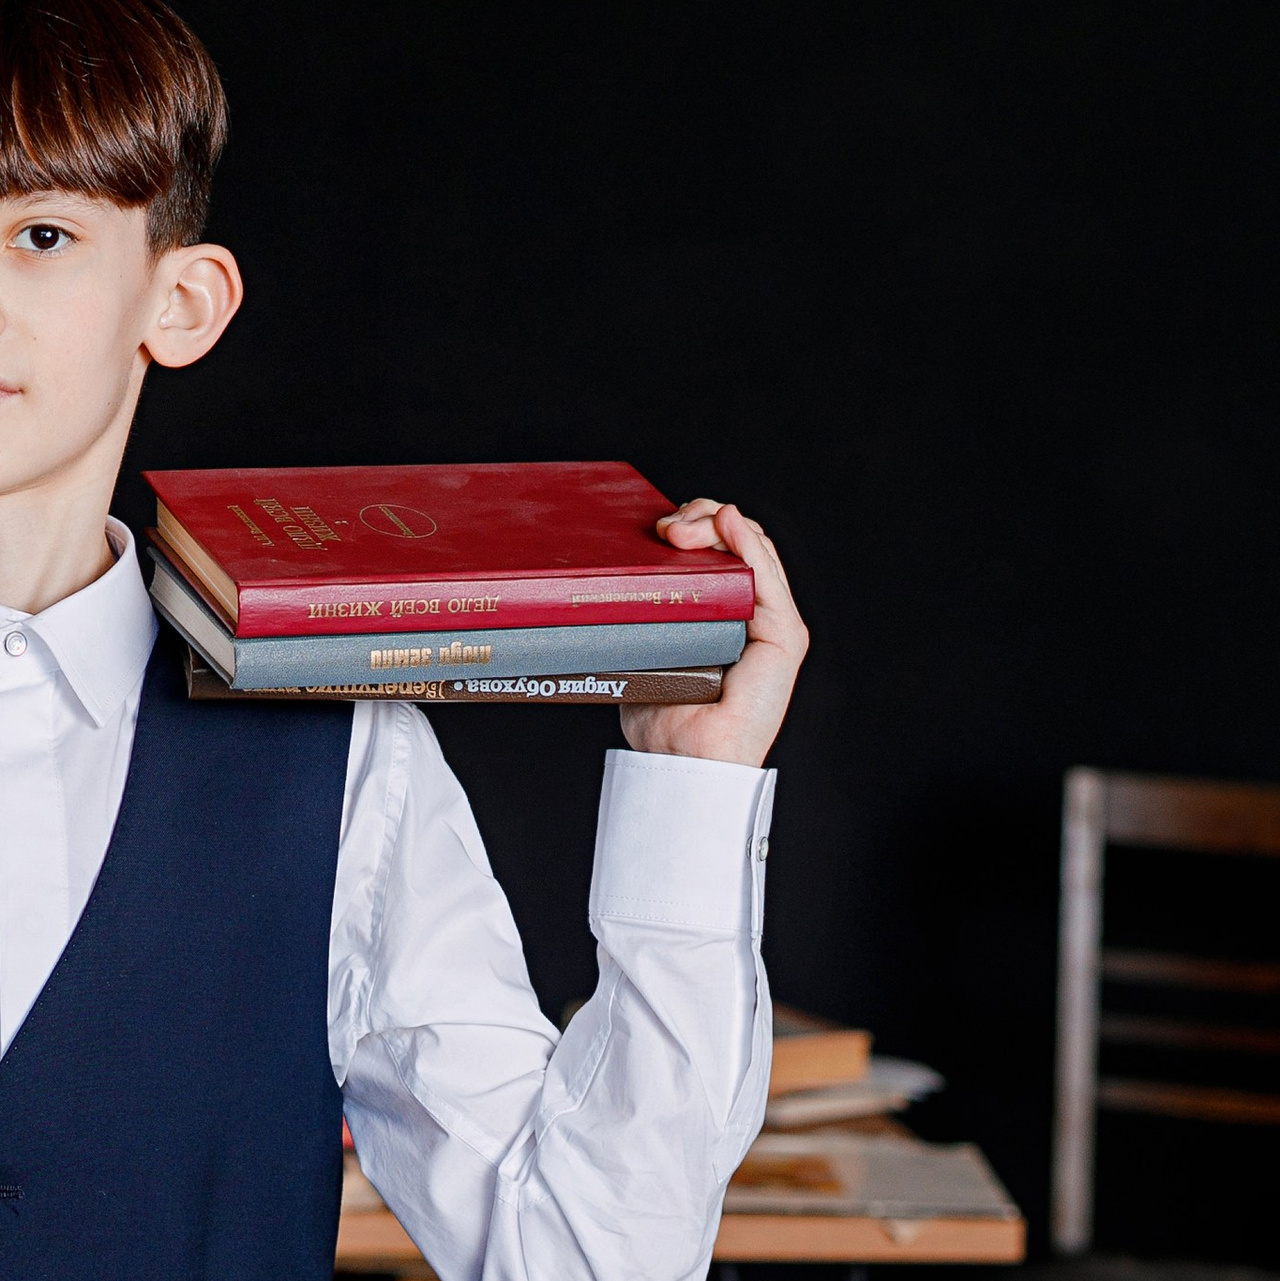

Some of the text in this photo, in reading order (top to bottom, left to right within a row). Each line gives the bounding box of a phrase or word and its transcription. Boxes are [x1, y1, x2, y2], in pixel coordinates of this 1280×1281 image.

[308, 595, 500, 619] ДЕЛО ВСЕЙ ЖИЗНИ
[467, 677, 557, 698] Обухова
[558, 676, 628, 698] Лидия
